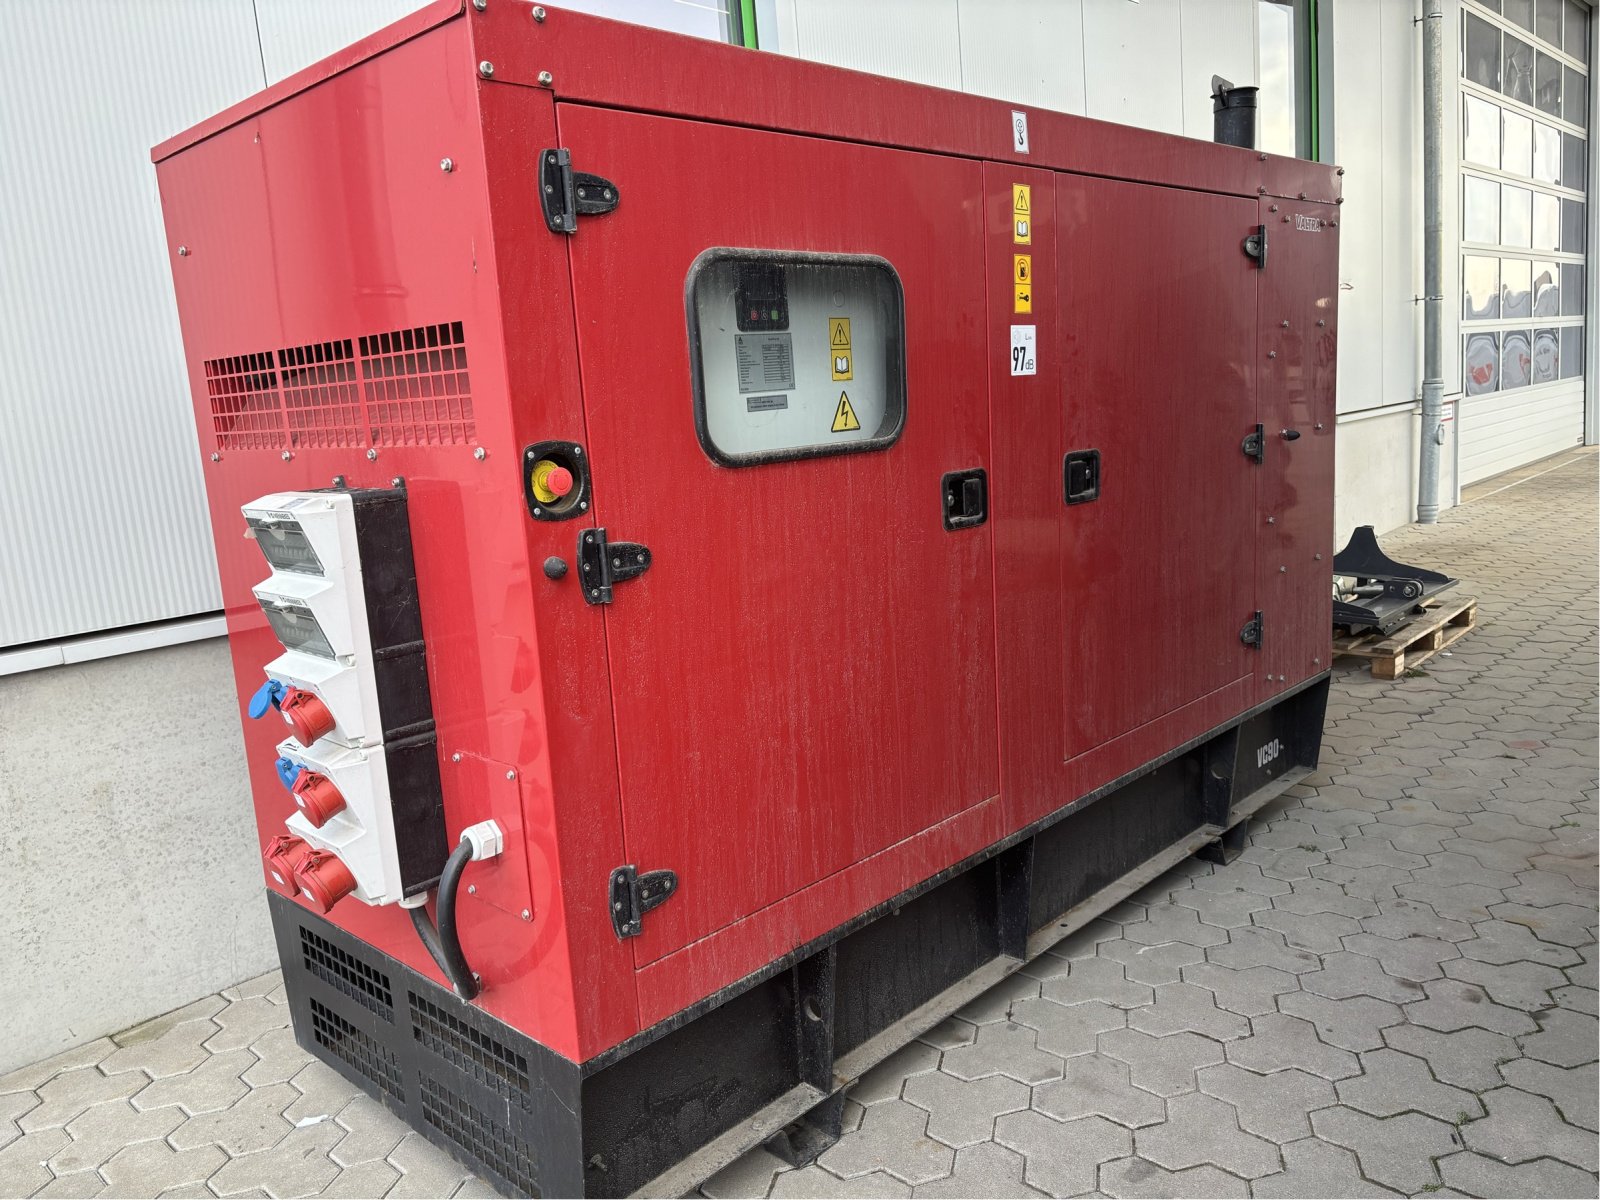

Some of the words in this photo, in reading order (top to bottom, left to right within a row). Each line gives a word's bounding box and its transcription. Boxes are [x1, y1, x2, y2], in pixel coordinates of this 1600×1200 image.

[1295, 214, 1321, 232] VALTRA
[1013, 346, 1026, 371] 97
[1025, 359, 1034, 370] dB
[1257, 738, 1279, 768] VC90
